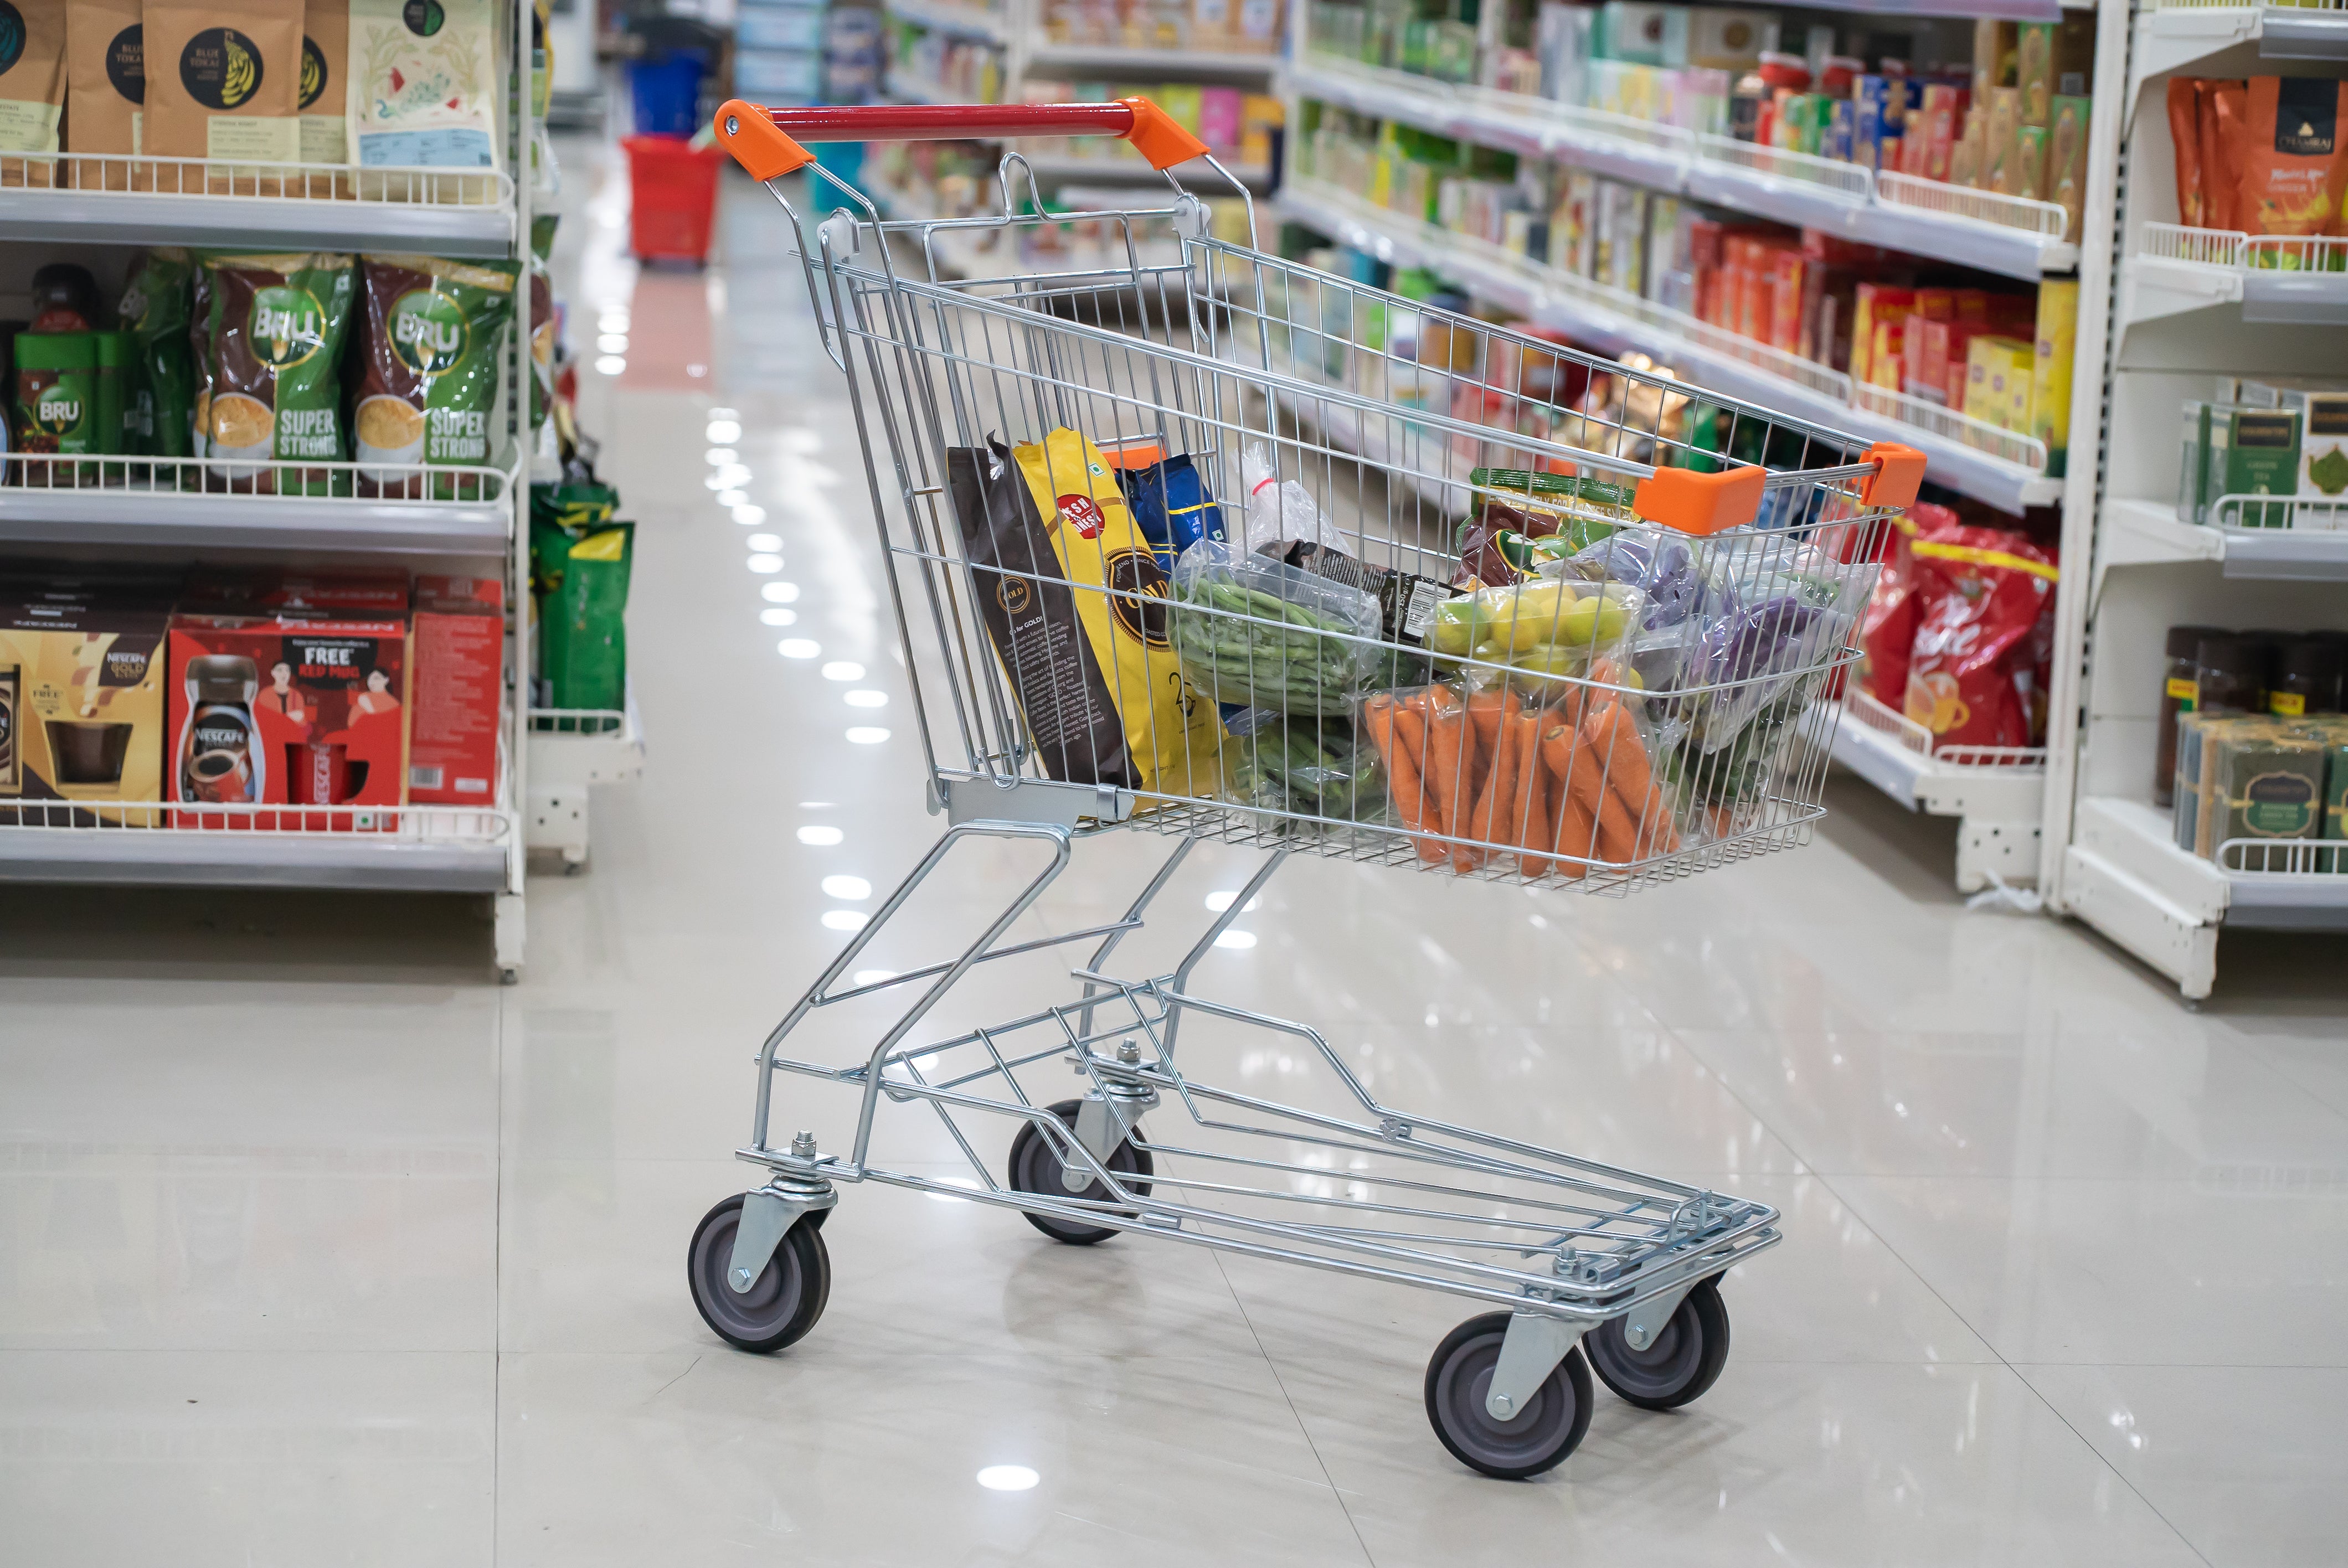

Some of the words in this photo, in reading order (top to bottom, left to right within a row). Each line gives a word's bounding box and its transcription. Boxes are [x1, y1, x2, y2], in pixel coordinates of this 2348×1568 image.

[255, 307, 315, 341] BRU
[397, 313, 459, 353] BRU
[40, 401, 79, 422] BRU
[280, 408, 336, 436] SUPER
[431, 410, 486, 437] SUPER
[280, 435, 337, 457] STRONG
[430, 435, 486, 460] STRONG
[1024, 616, 1043, 628] GOLD!
[1055, 625, 1070, 633] coffee
[298, 664, 326, 678] RED
[1064, 662, 1078, 670] coffee
[1069, 704, 1082, 712] Indian
[1069, 710, 1084, 719] tribute
[1090, 710, 1102, 718] pack
[1064, 728, 1075, 736] blend
